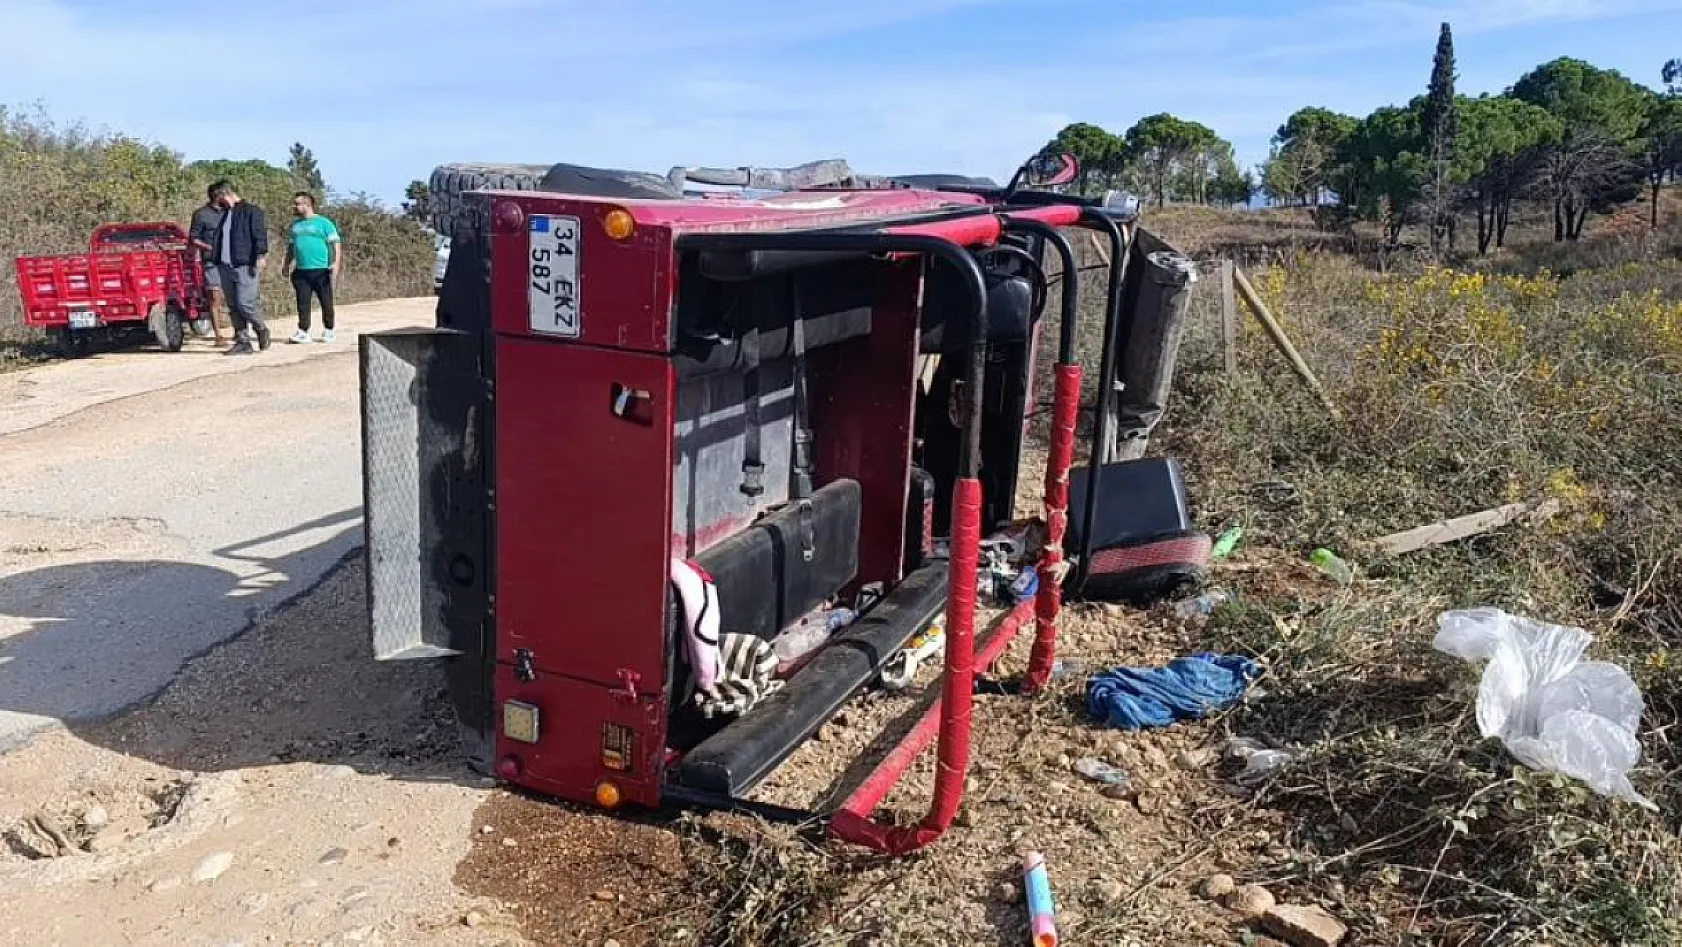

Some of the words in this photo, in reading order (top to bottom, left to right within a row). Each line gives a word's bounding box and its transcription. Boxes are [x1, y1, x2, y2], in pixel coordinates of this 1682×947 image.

[554, 227, 574, 257] 34
[532, 247, 551, 295] 587
[554, 279, 573, 328] EKZ
